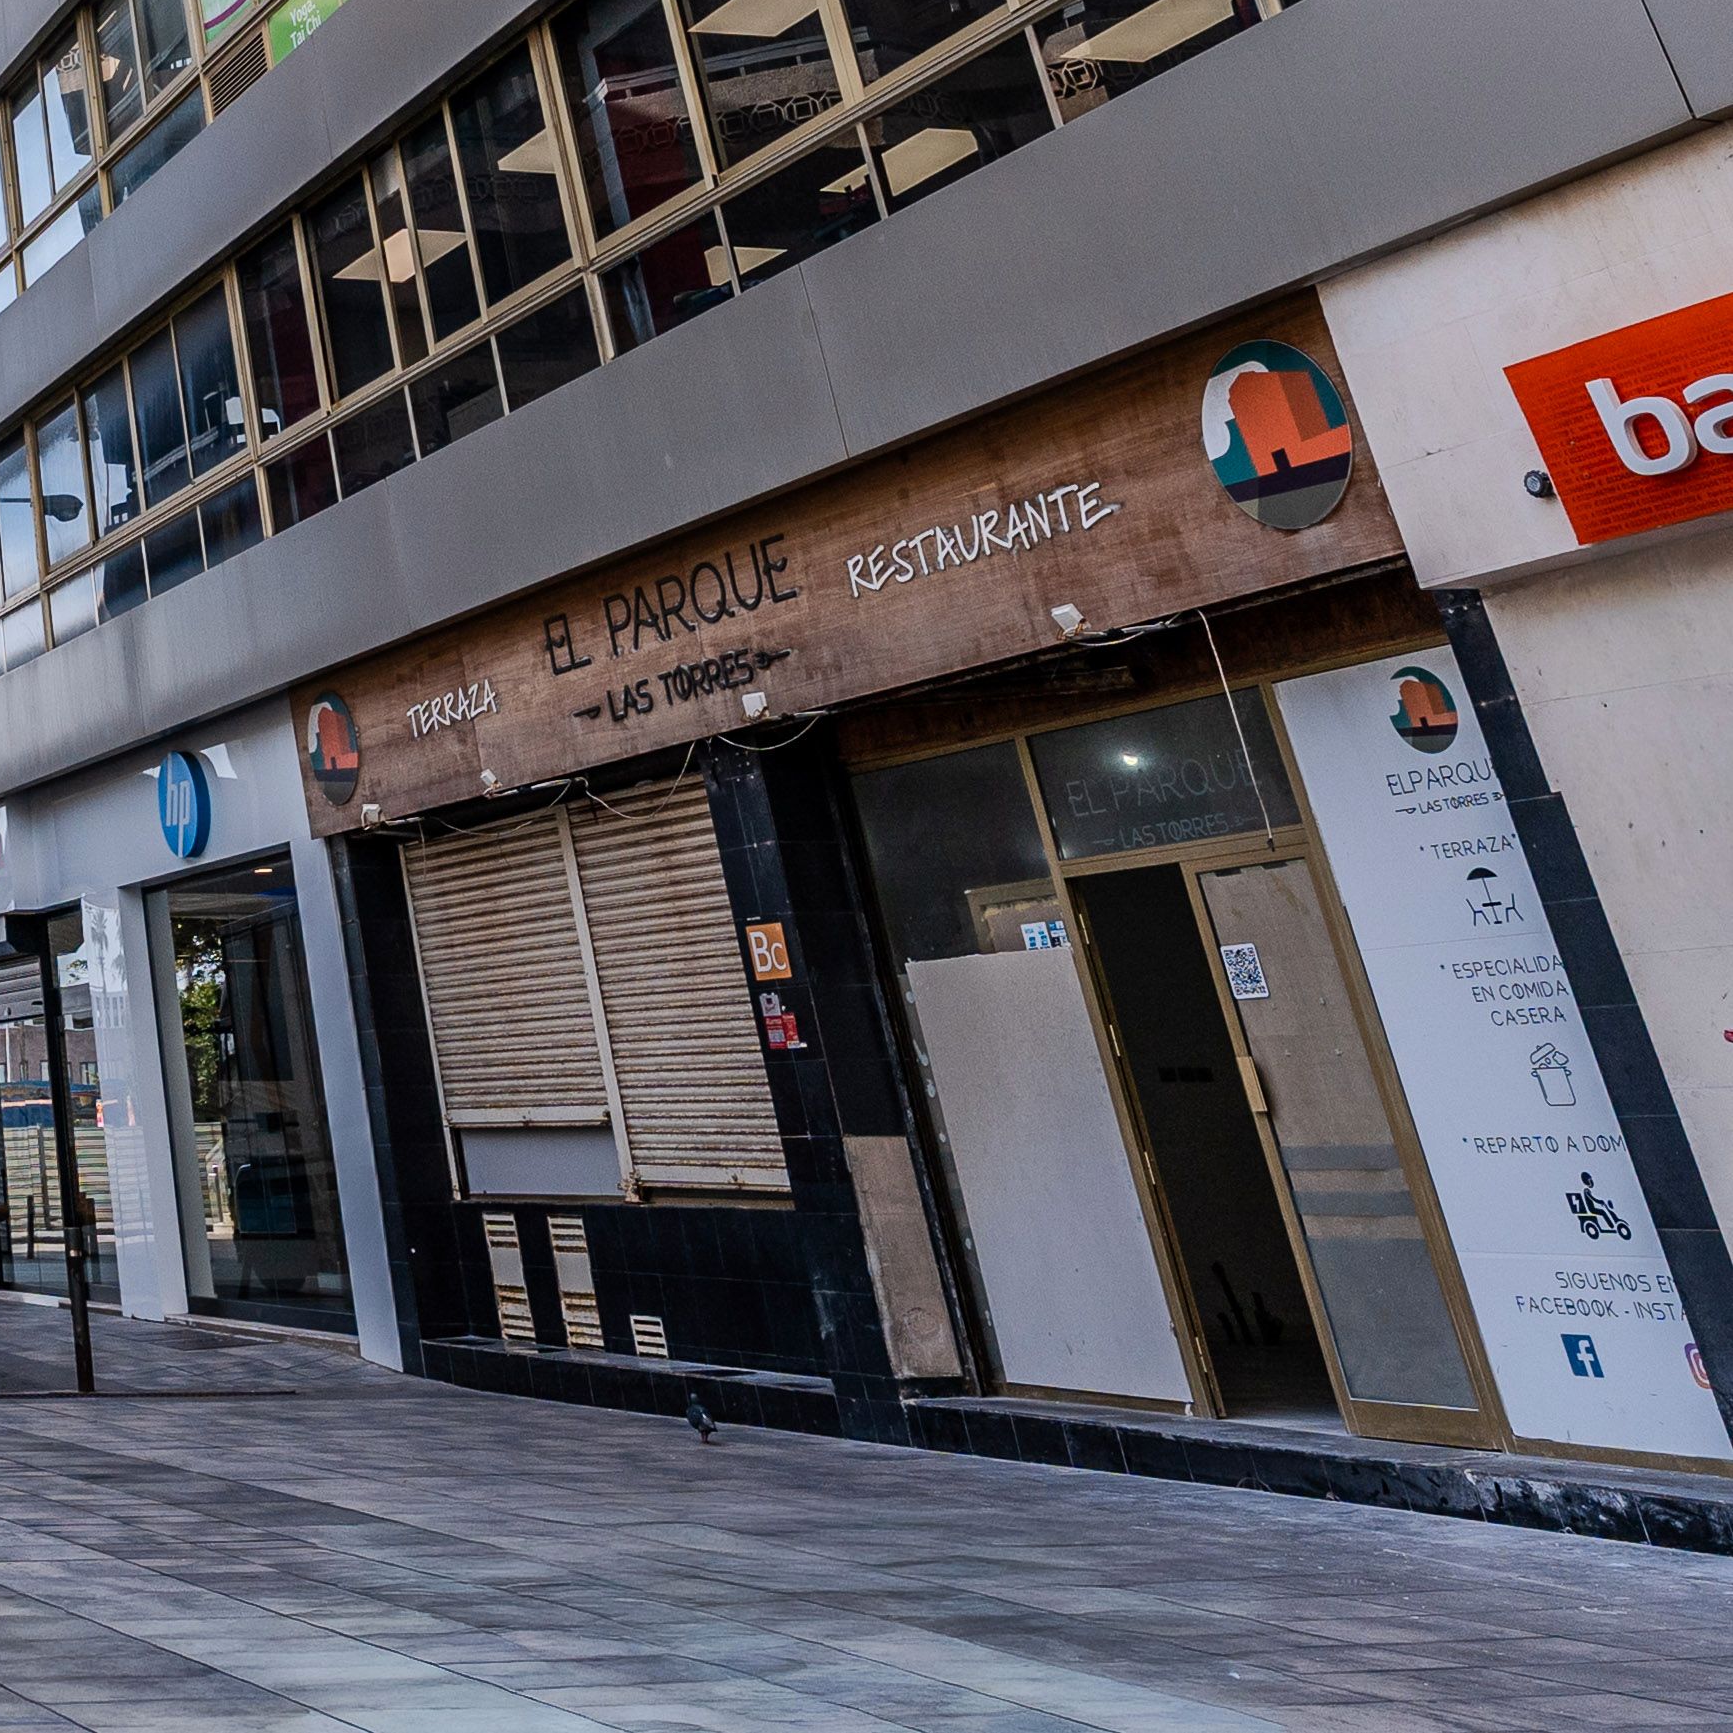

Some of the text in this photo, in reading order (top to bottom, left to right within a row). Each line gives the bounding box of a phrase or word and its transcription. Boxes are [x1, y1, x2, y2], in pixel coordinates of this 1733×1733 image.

[846, 482, 1113, 598] RESTAURANTE
[542, 532, 801, 677] EL PARQUE
[606, 647, 755, 722] LAS TORRES
[406, 677, 499, 741] TERRAZA
[1065, 746, 1263, 818] EL PARQUE
[165, 751, 192, 859] hp
[1118, 811, 1231, 850] LAS TORRES
[1430, 834, 1515, 860] TERRAZA
[749, 930, 787, 974] Bc
[1471, 979, 1570, 1003] EN COMIDA
[1490, 1005, 1567, 1027] CASERA
[1473, 1135, 1560, 1155] REPARTO
[1566, 1135, 1581, 1153] A
[1555, 1271, 1652, 1293] SIGUENOS
[1515, 1295, 1620, 1319] FACEBOOK
